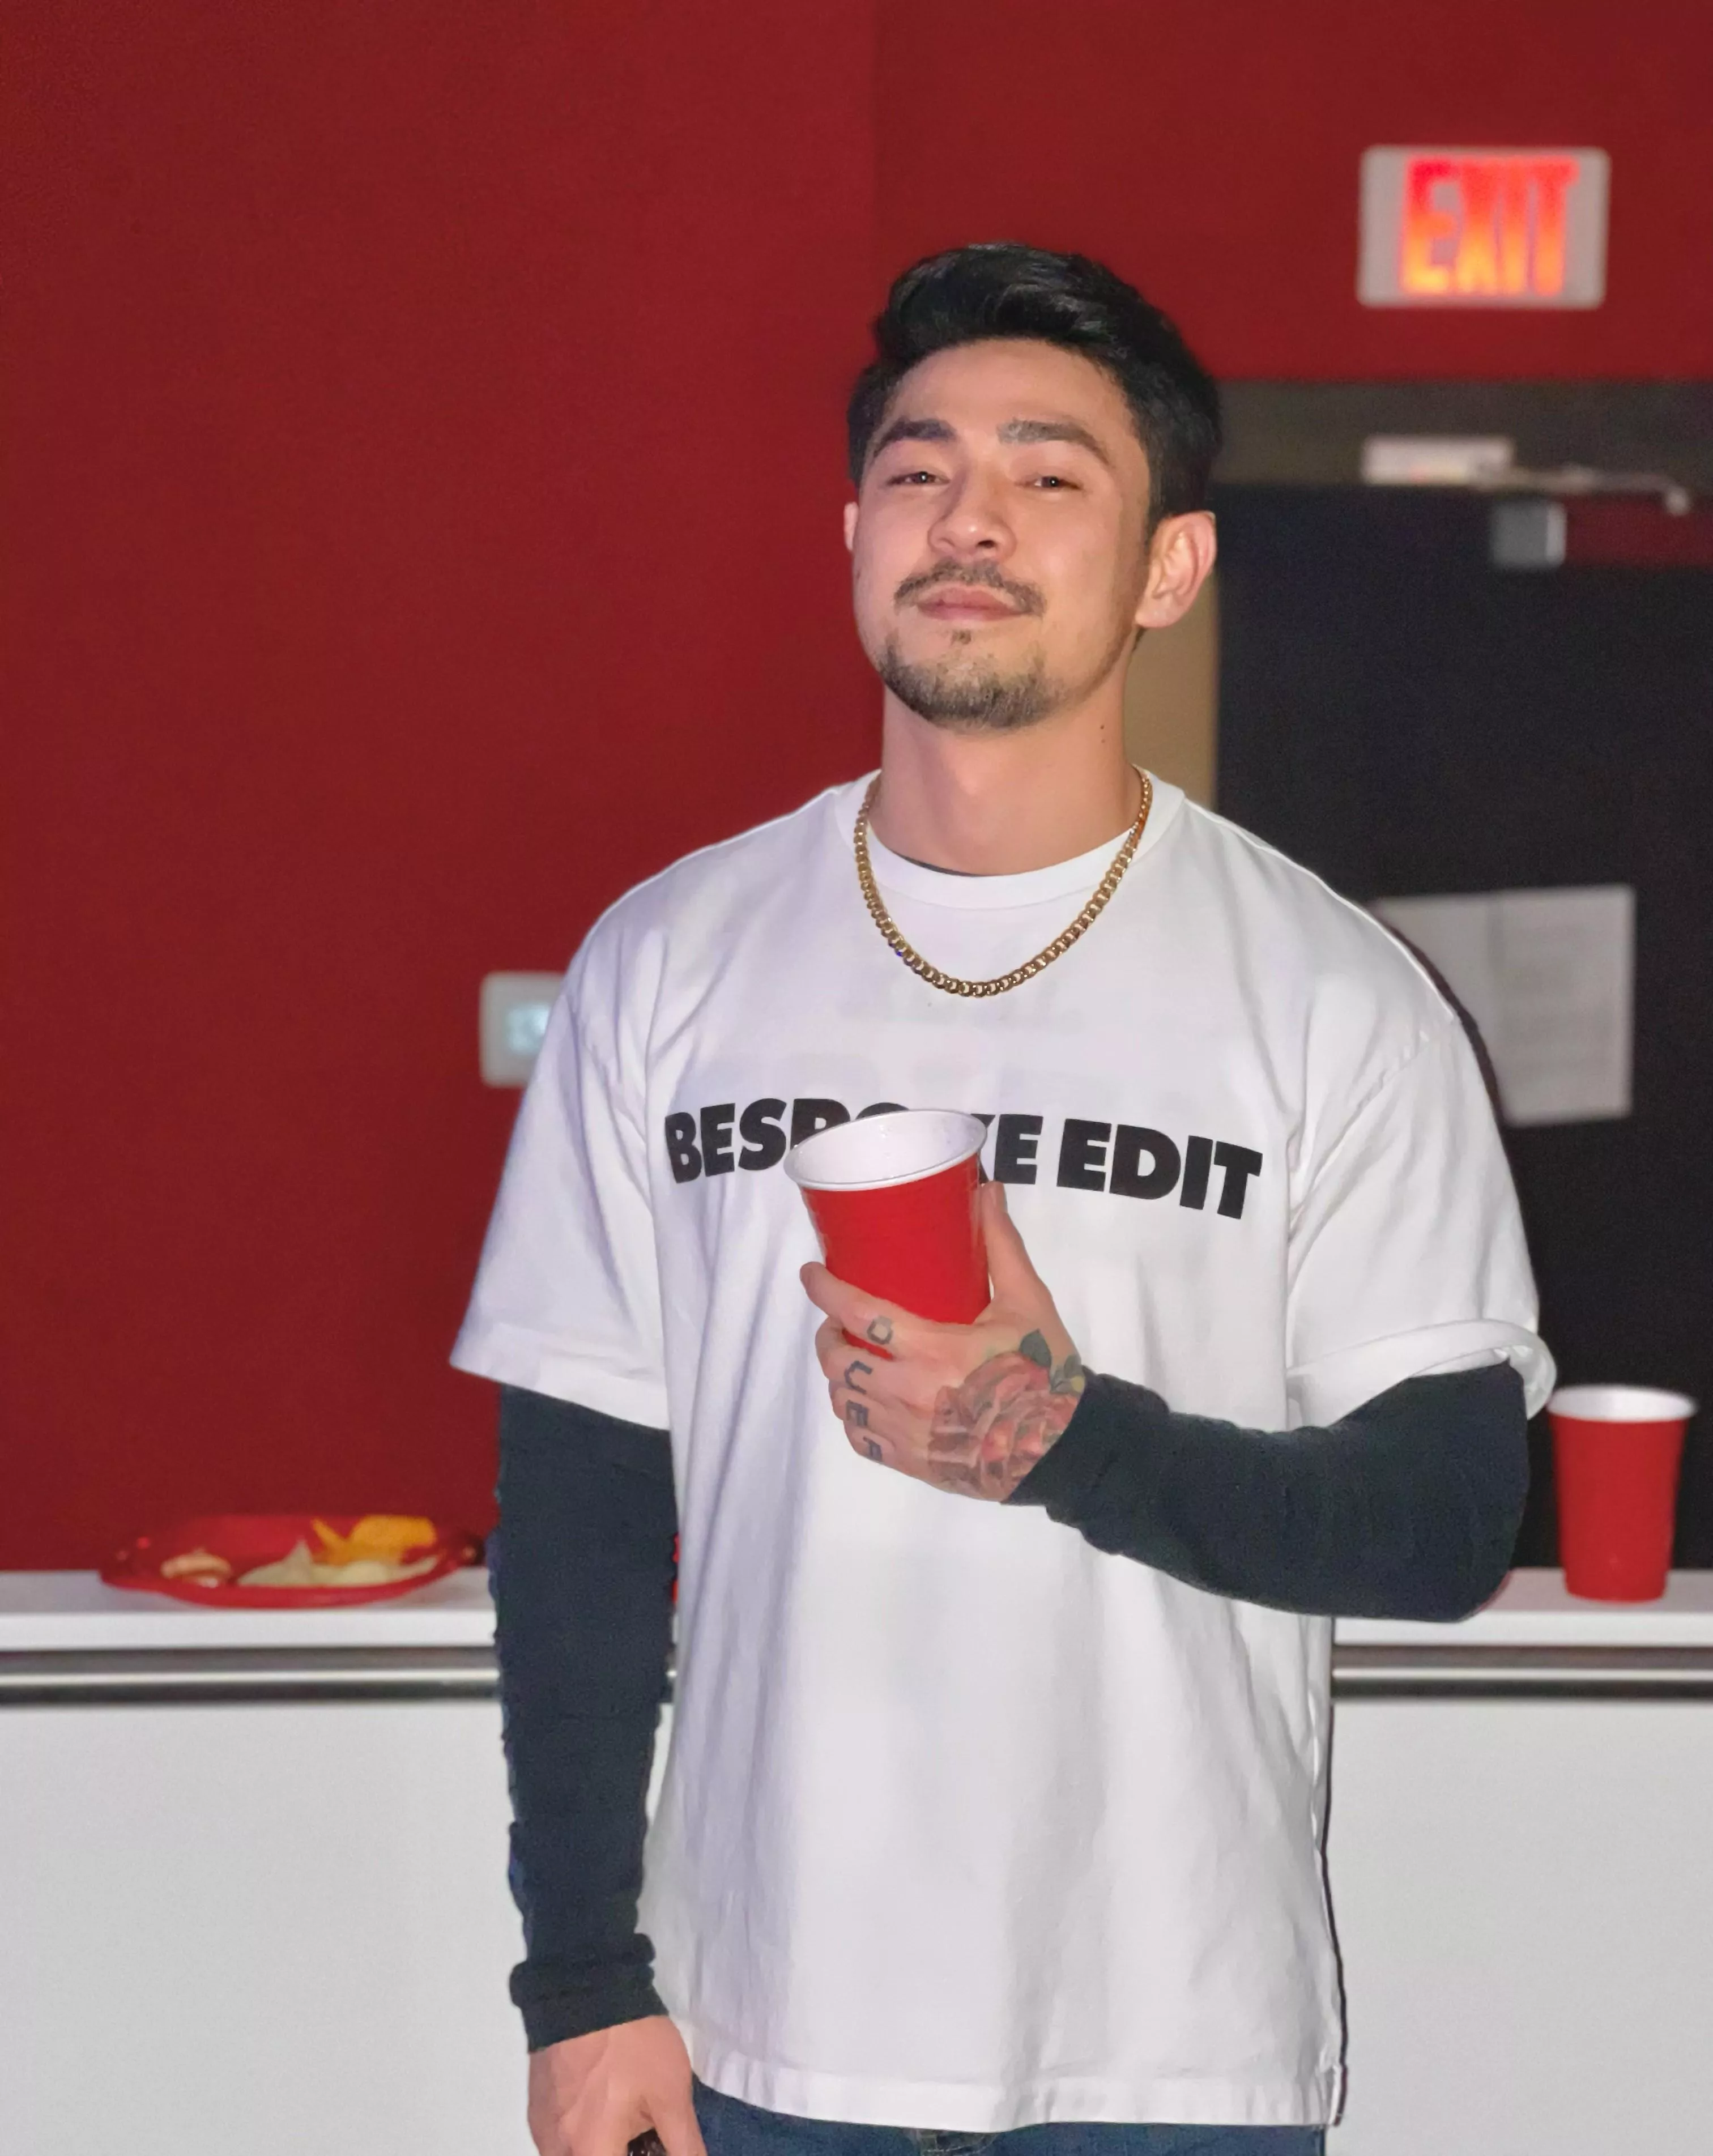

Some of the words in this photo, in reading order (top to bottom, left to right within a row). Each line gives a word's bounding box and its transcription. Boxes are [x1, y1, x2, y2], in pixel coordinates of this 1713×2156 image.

[1403, 156, 1579, 296] EXIT
[665, 1098, 1043, 1184] BESPE
[1056, 1118, 1263, 1220] EDIT
